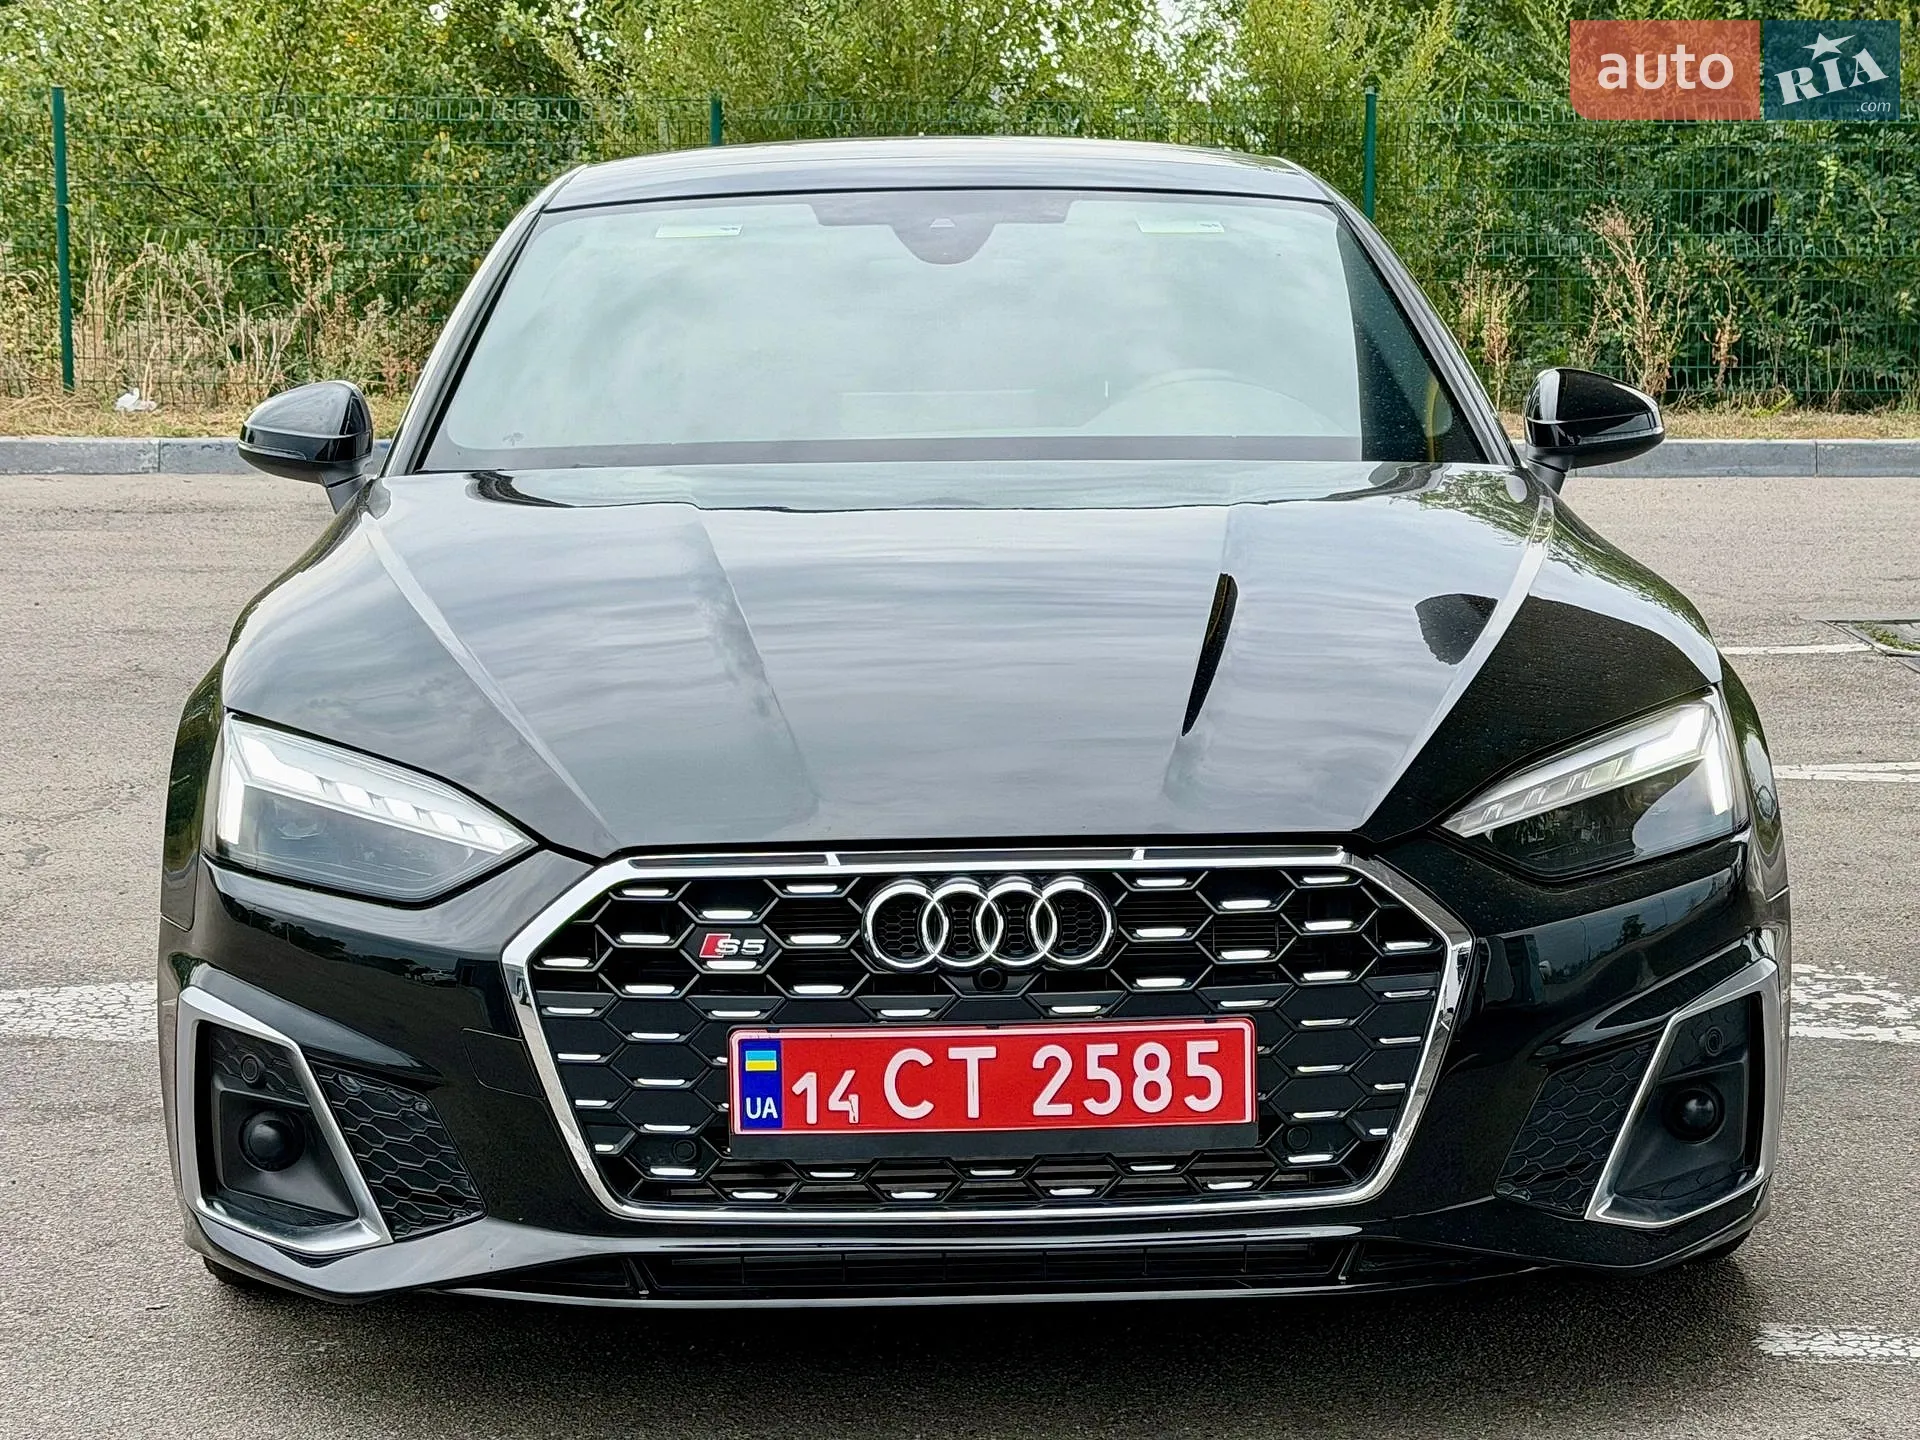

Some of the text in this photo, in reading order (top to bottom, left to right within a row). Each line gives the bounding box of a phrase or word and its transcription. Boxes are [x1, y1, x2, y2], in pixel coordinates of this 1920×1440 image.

[714, 938, 767, 956] S5
[791, 1040, 1223, 1125] 14 CT 2585
[745, 1097, 778, 1119] UA
